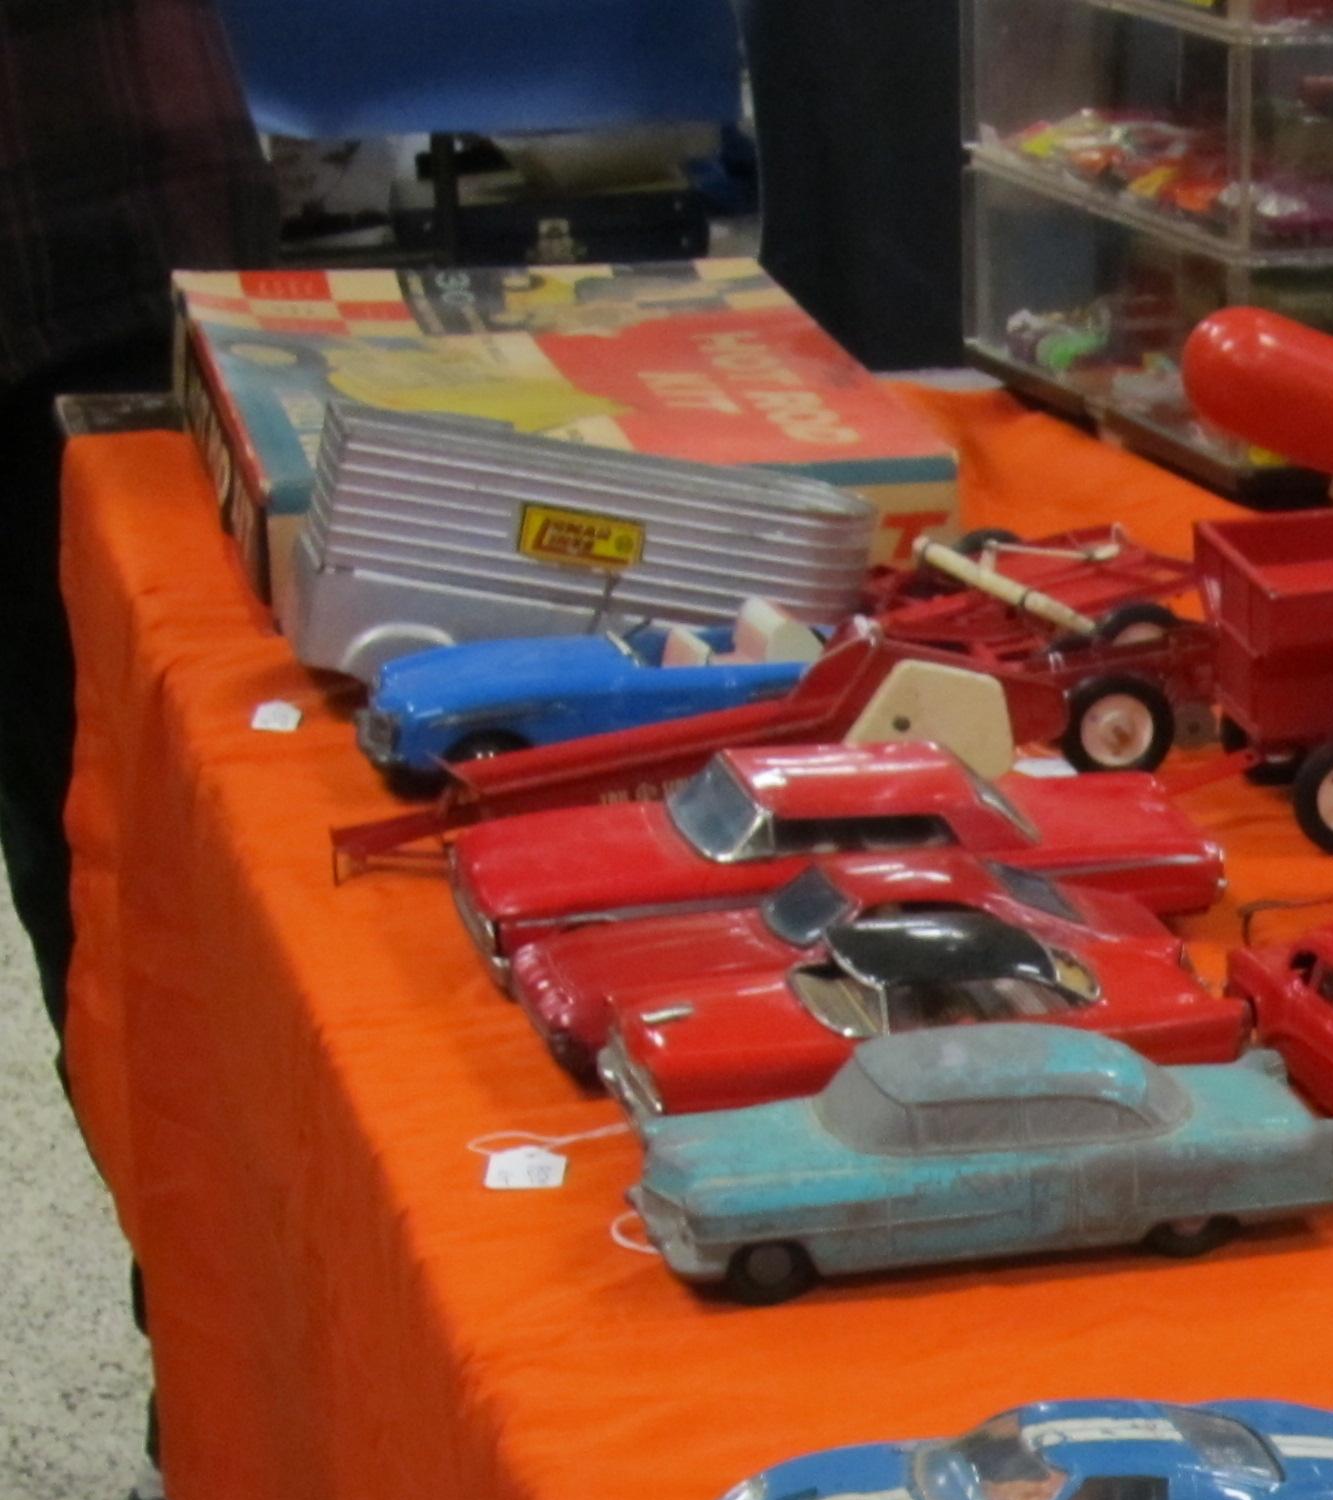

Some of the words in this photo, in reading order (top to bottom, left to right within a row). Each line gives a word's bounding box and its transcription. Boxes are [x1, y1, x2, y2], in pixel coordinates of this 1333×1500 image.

[690, 330, 803, 387] HOT
[636, 370, 743, 416] KIT
[744, 390, 861, 446] ROD
